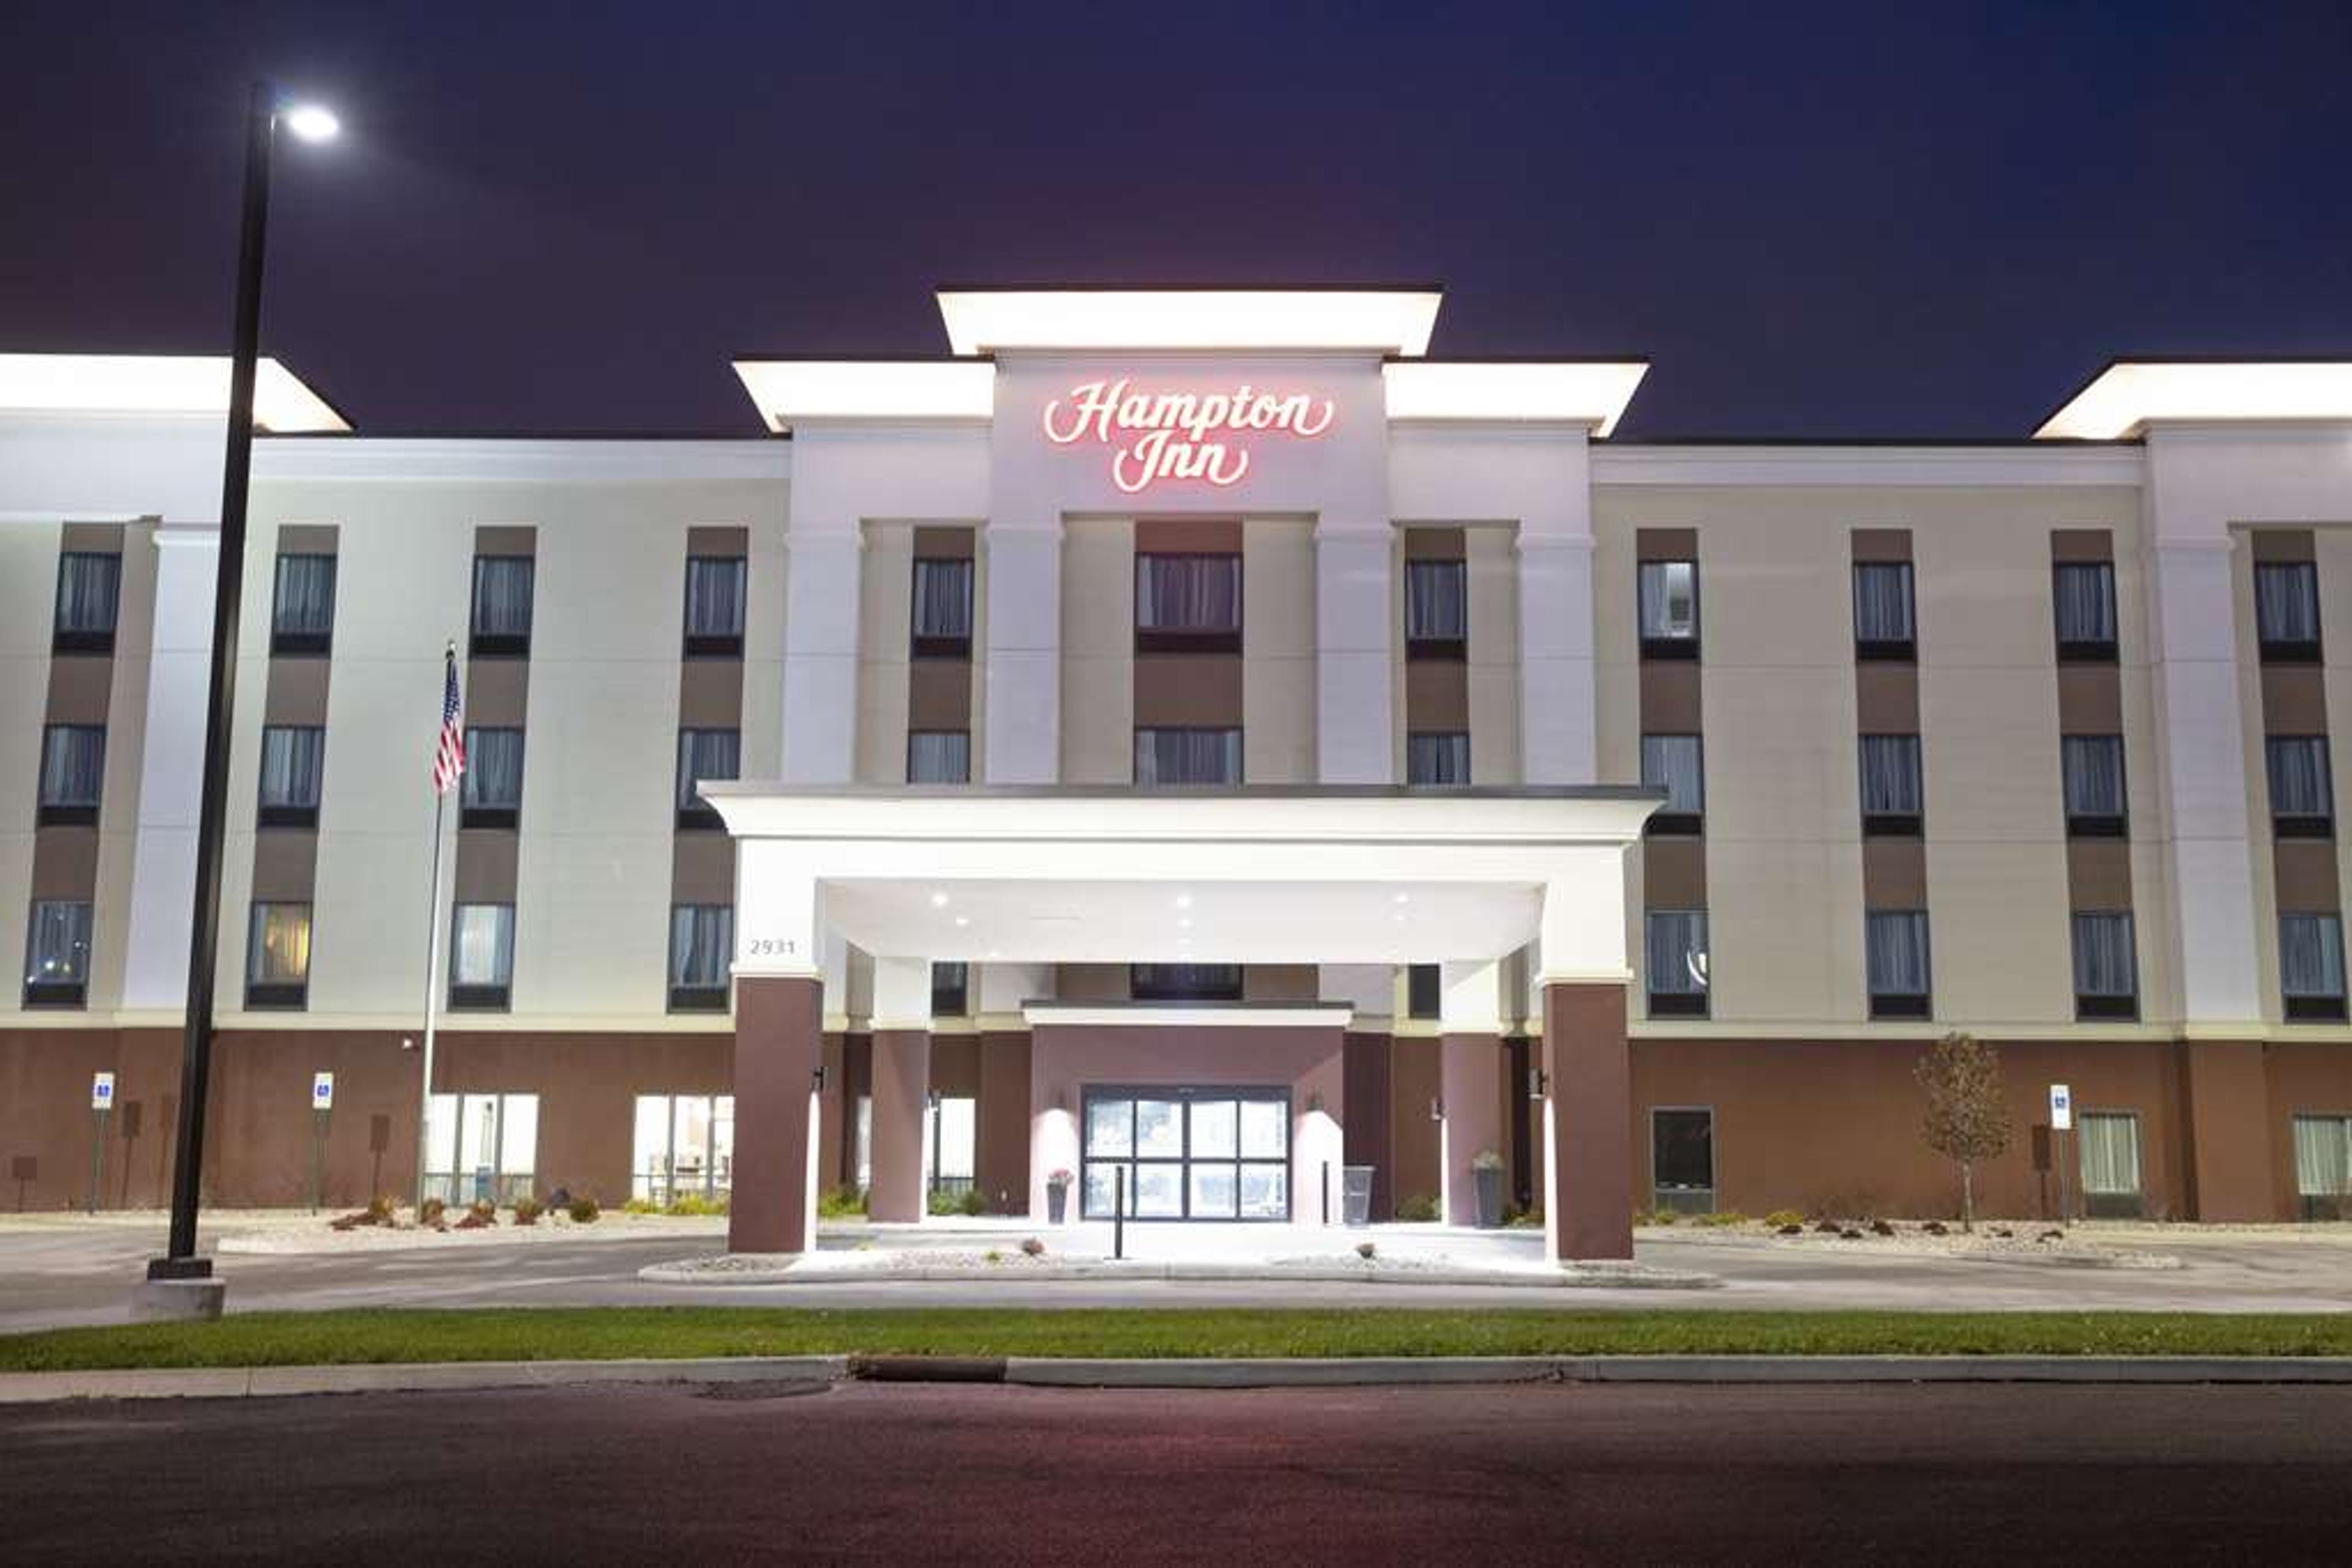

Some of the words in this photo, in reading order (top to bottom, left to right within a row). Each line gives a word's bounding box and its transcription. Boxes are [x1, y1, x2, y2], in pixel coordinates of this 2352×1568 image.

[1044, 379, 1334, 442] Hampton
[1113, 430, 1249, 492] Inn
[750, 938, 794, 955] 2931
